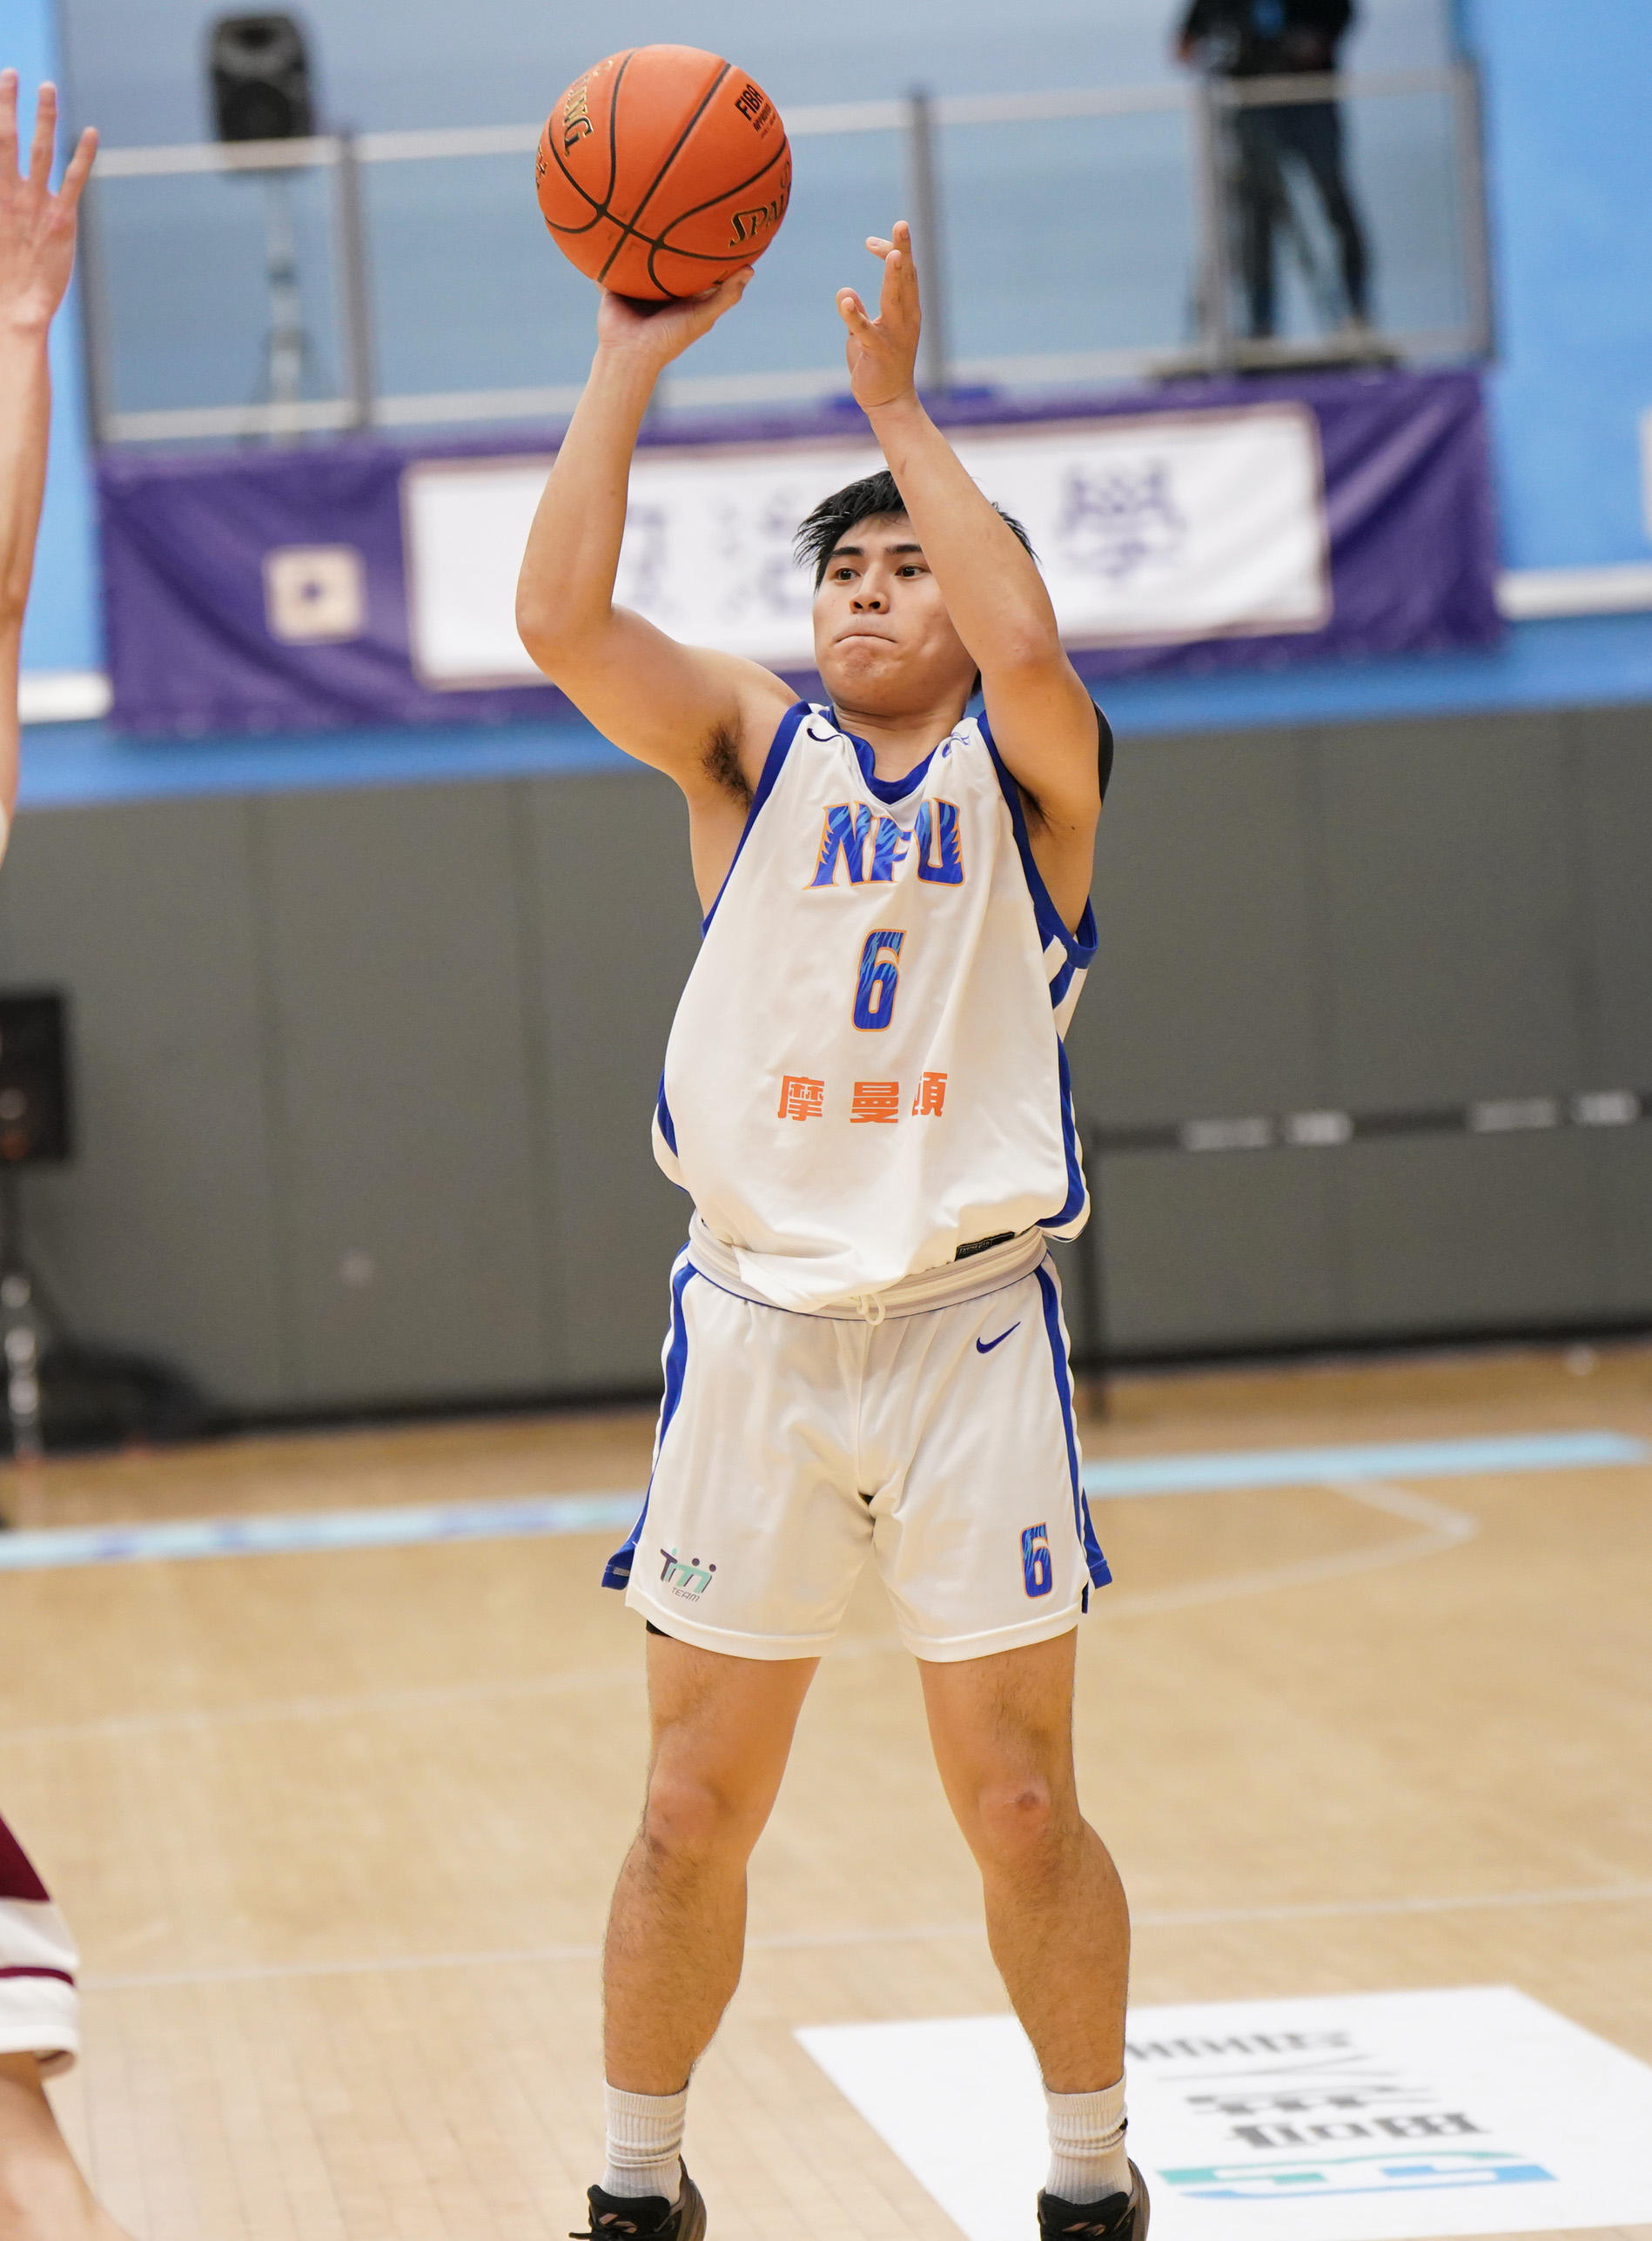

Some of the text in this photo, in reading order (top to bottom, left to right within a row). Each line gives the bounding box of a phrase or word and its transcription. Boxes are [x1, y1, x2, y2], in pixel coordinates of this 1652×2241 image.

[735, 84, 763, 122] FIBA
[802, 797, 966, 890] NFU
[850, 928, 907, 1032] 6
[671, 1587, 701, 1602] TEAM
[1019, 1521, 1053, 1600] 6
